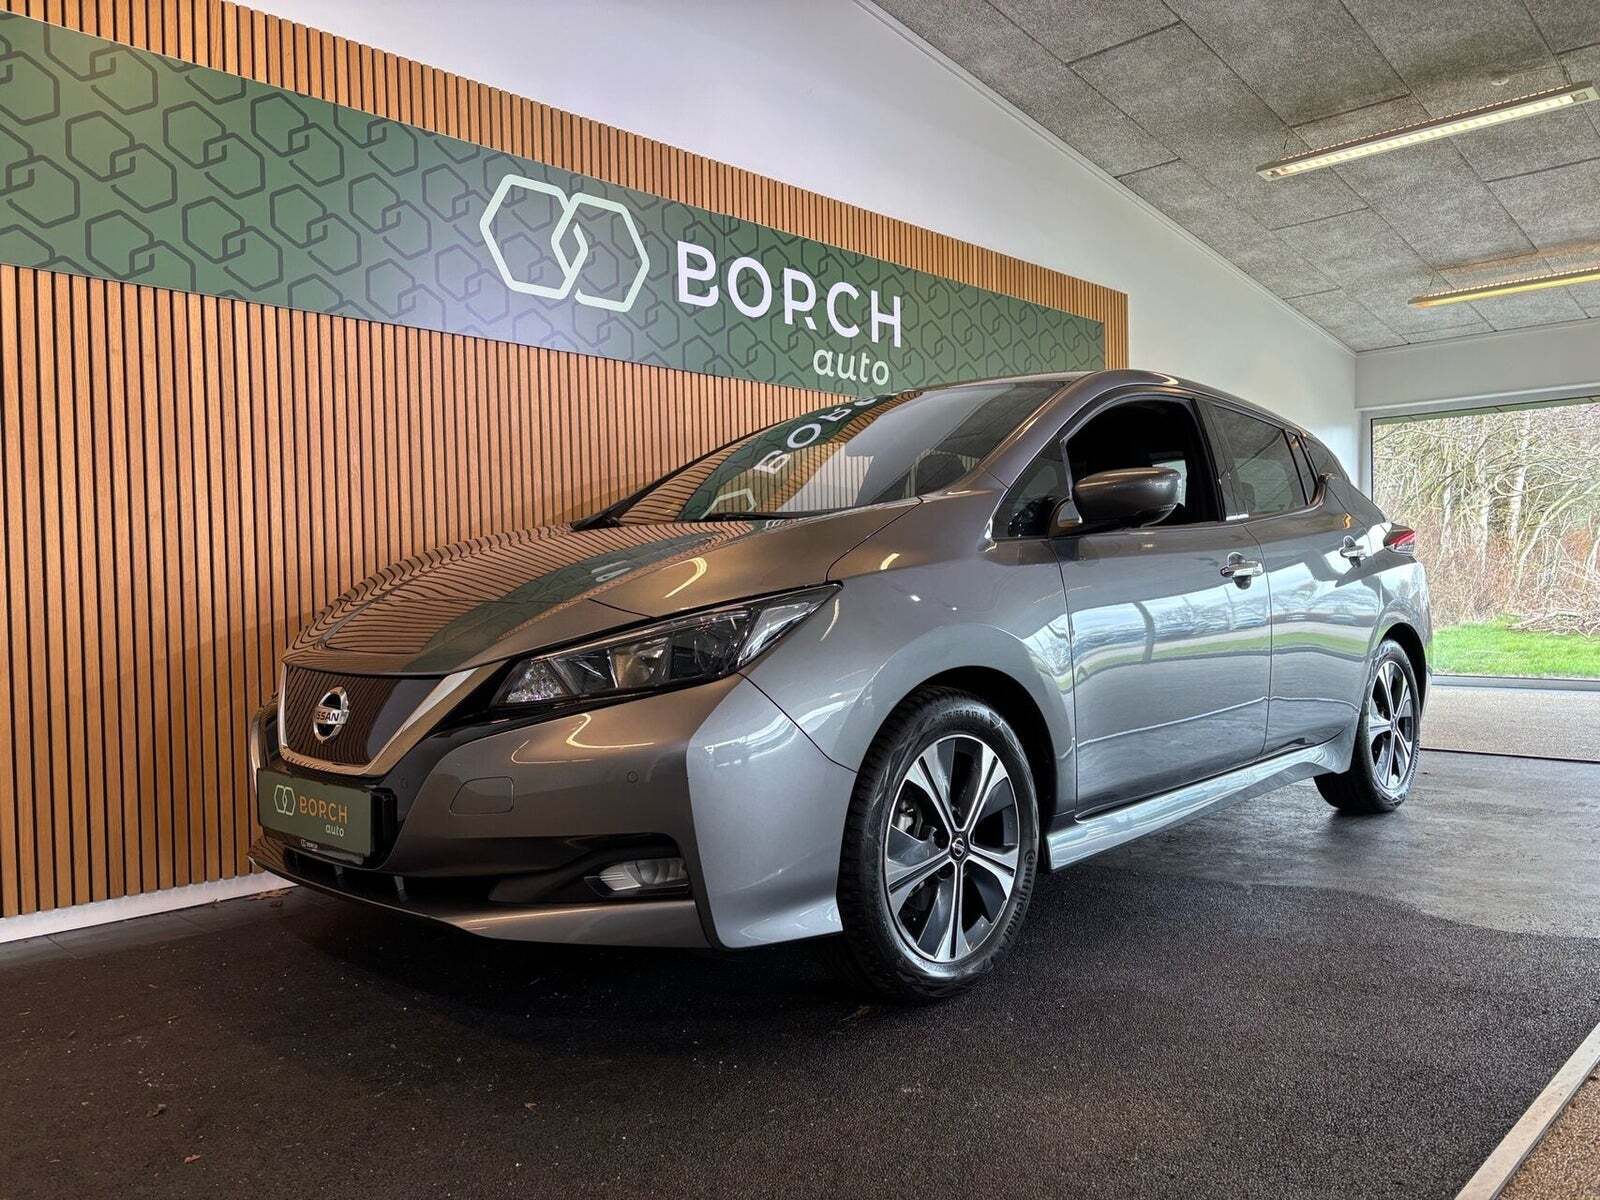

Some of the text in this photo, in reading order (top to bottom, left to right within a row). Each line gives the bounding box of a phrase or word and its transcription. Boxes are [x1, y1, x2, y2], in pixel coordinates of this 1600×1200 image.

[677, 240, 902, 348] BORCH
[812, 349, 890, 386] auto
[314, 710, 340, 722] SSAN
[299, 795, 348, 825] BORCH
[325, 824, 345, 838] auto
